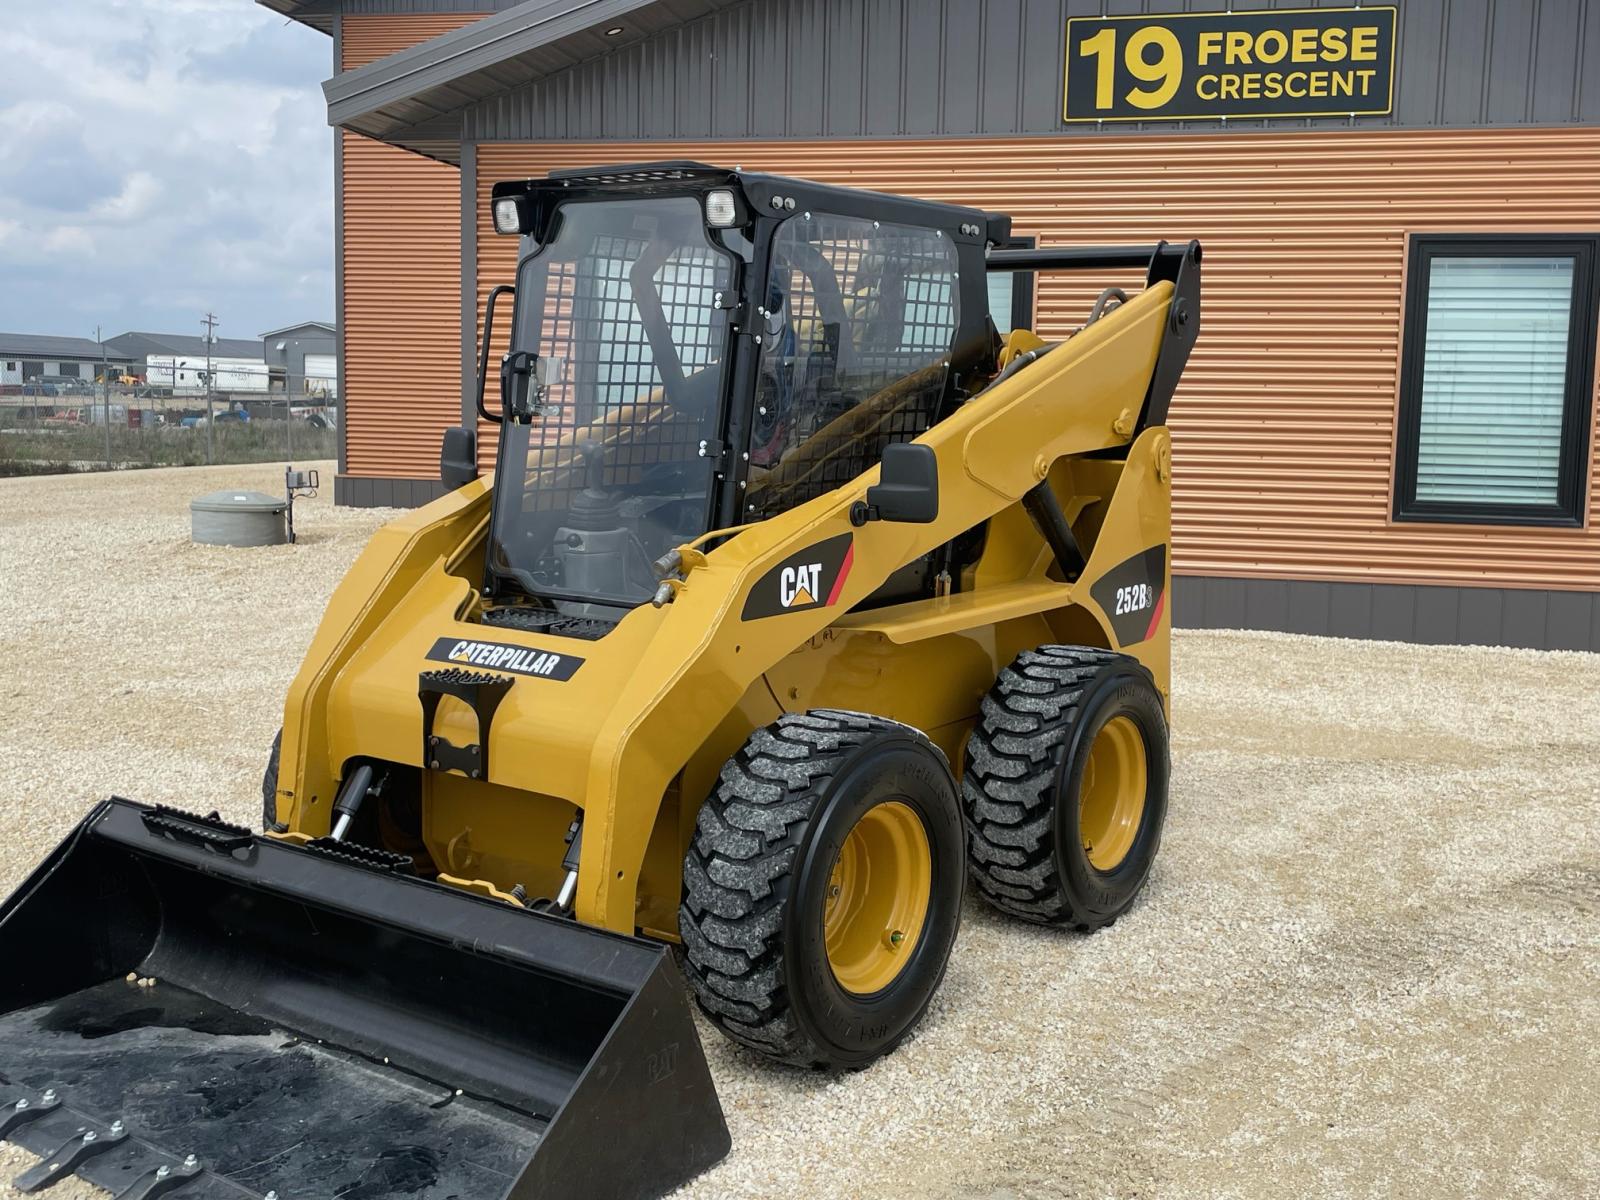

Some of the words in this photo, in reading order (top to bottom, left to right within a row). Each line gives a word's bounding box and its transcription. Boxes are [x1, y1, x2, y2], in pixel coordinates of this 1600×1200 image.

[1198, 27, 1379, 66] FROESE
[1080, 26, 1183, 110] 19
[1196, 70, 1376, 100] CRESCENT
[780, 563, 822, 607] CAT
[448, 641, 561, 675] CATERPILLAR
